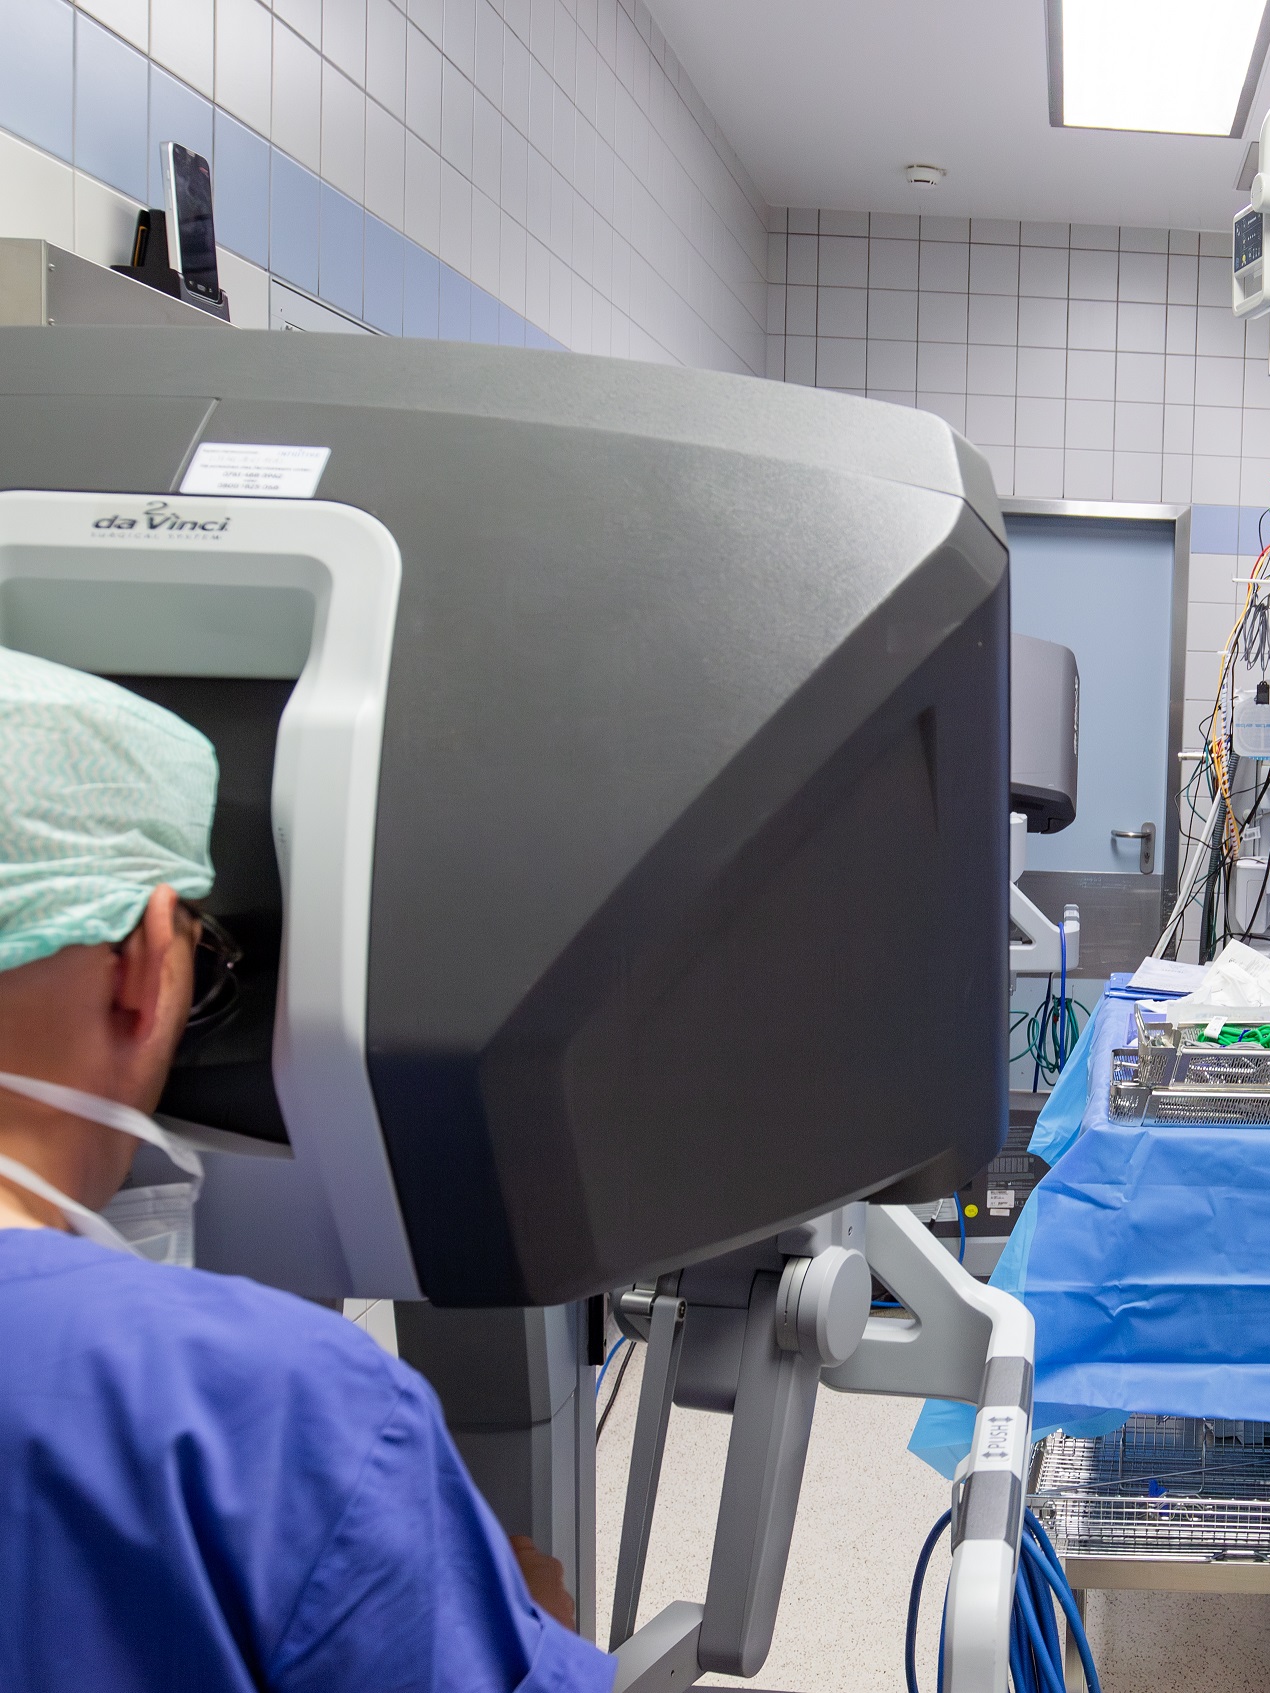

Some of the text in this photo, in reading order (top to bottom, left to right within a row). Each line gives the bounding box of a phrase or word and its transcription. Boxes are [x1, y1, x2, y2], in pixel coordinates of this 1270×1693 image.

[93, 512, 231, 531] da Vinci
[988, 1425, 1009, 1449] PUSH
